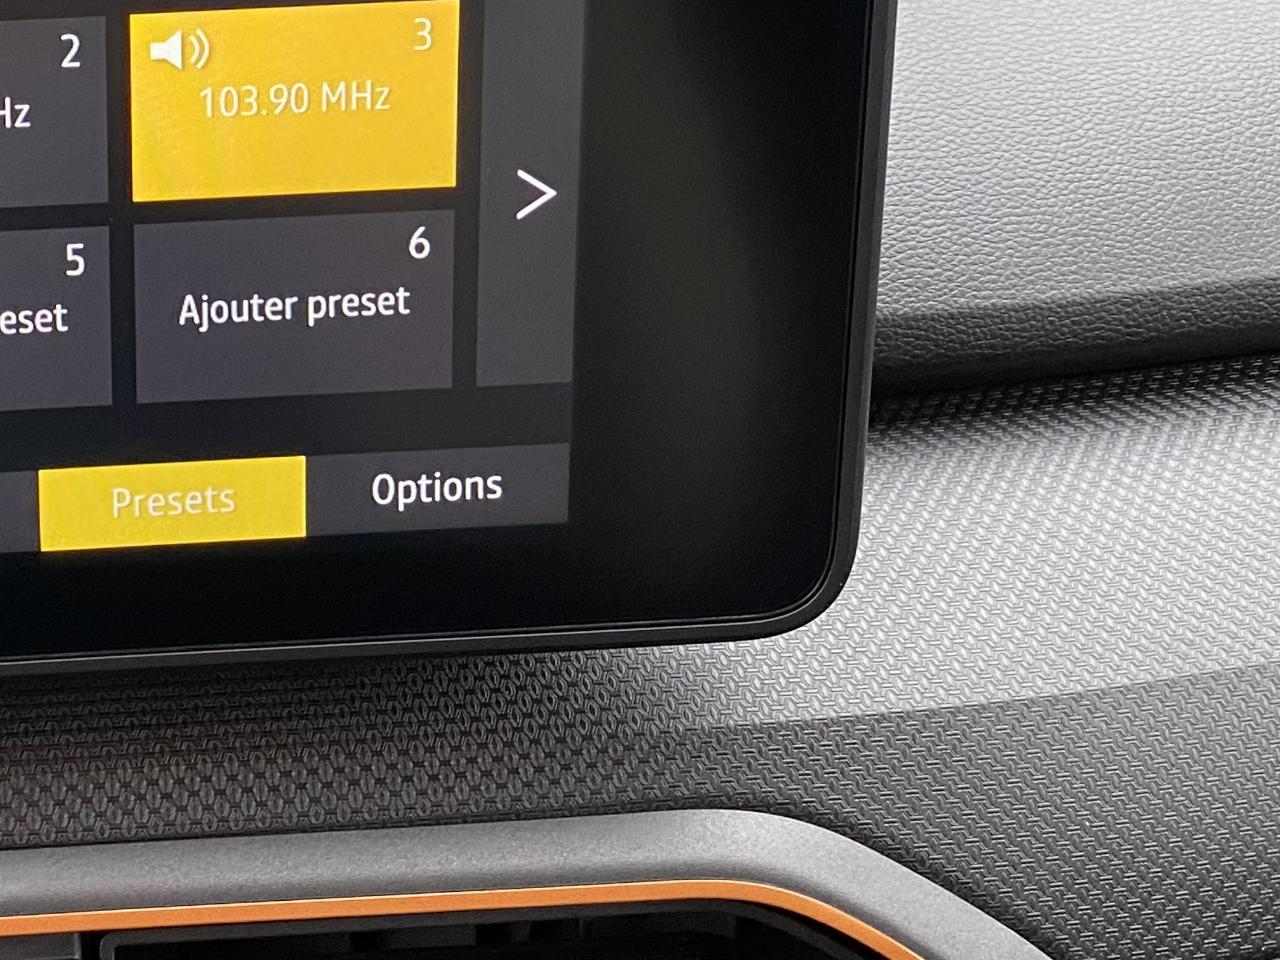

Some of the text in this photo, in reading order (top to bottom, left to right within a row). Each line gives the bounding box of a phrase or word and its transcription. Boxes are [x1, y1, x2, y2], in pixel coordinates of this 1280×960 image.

[60, 33, 81, 68] 2
[414, 17, 433, 52] 3
[200, 79, 392, 119] 103.90 MHz
[65, 242, 86, 277] 5
[408, 225, 431, 260] 6
[178, 285, 412, 334] Ajouter preset
[111, 486, 237, 520] Presets
[371, 470, 504, 513] Options
